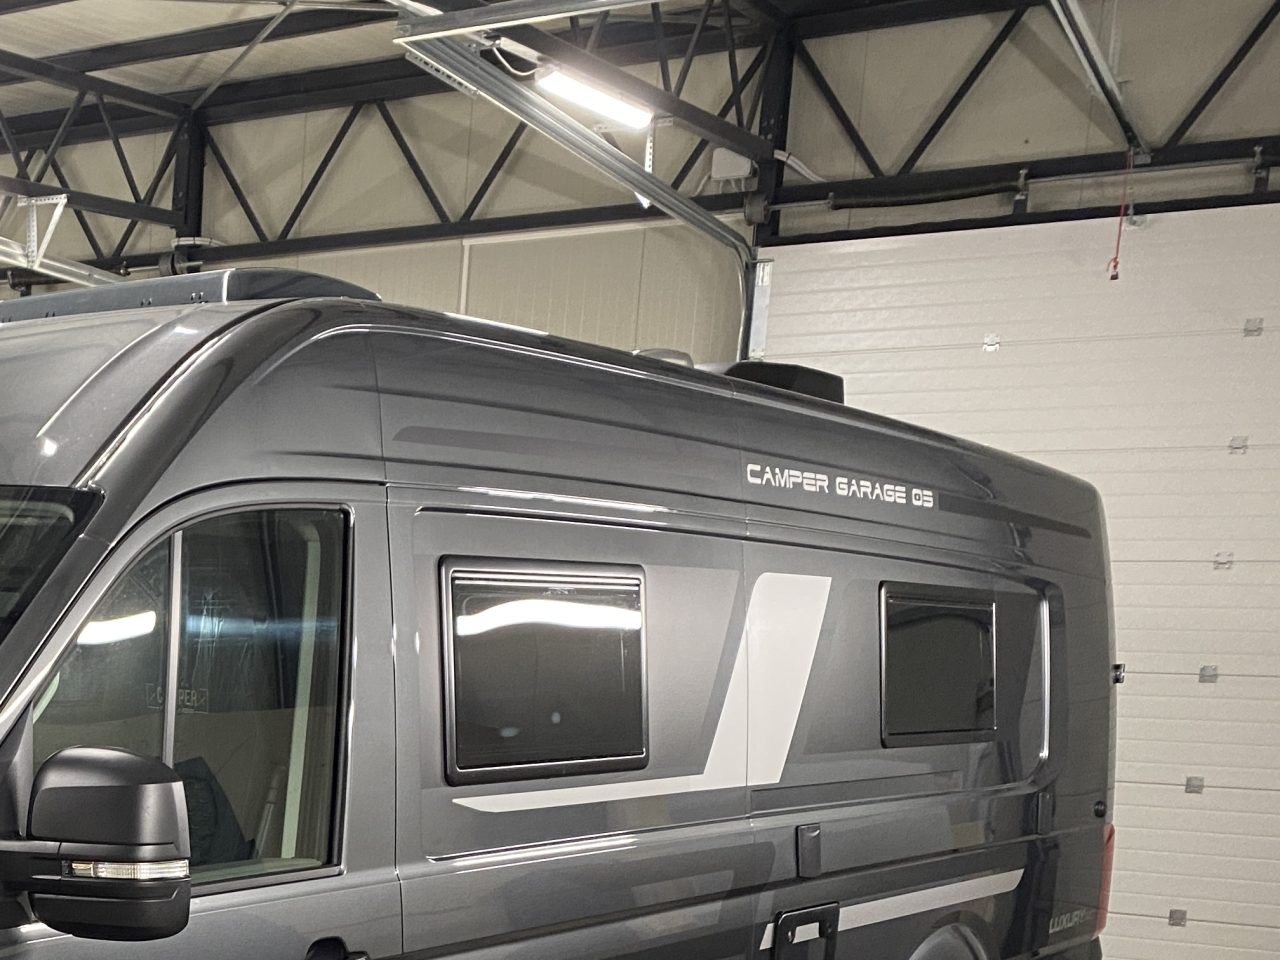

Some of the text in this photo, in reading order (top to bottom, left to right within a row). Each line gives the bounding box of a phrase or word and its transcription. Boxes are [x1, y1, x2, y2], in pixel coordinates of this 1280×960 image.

[746, 463, 829, 494] CAMPER
[835, 476, 907, 504] GARAGE
[156, 686, 197, 707] CPER
